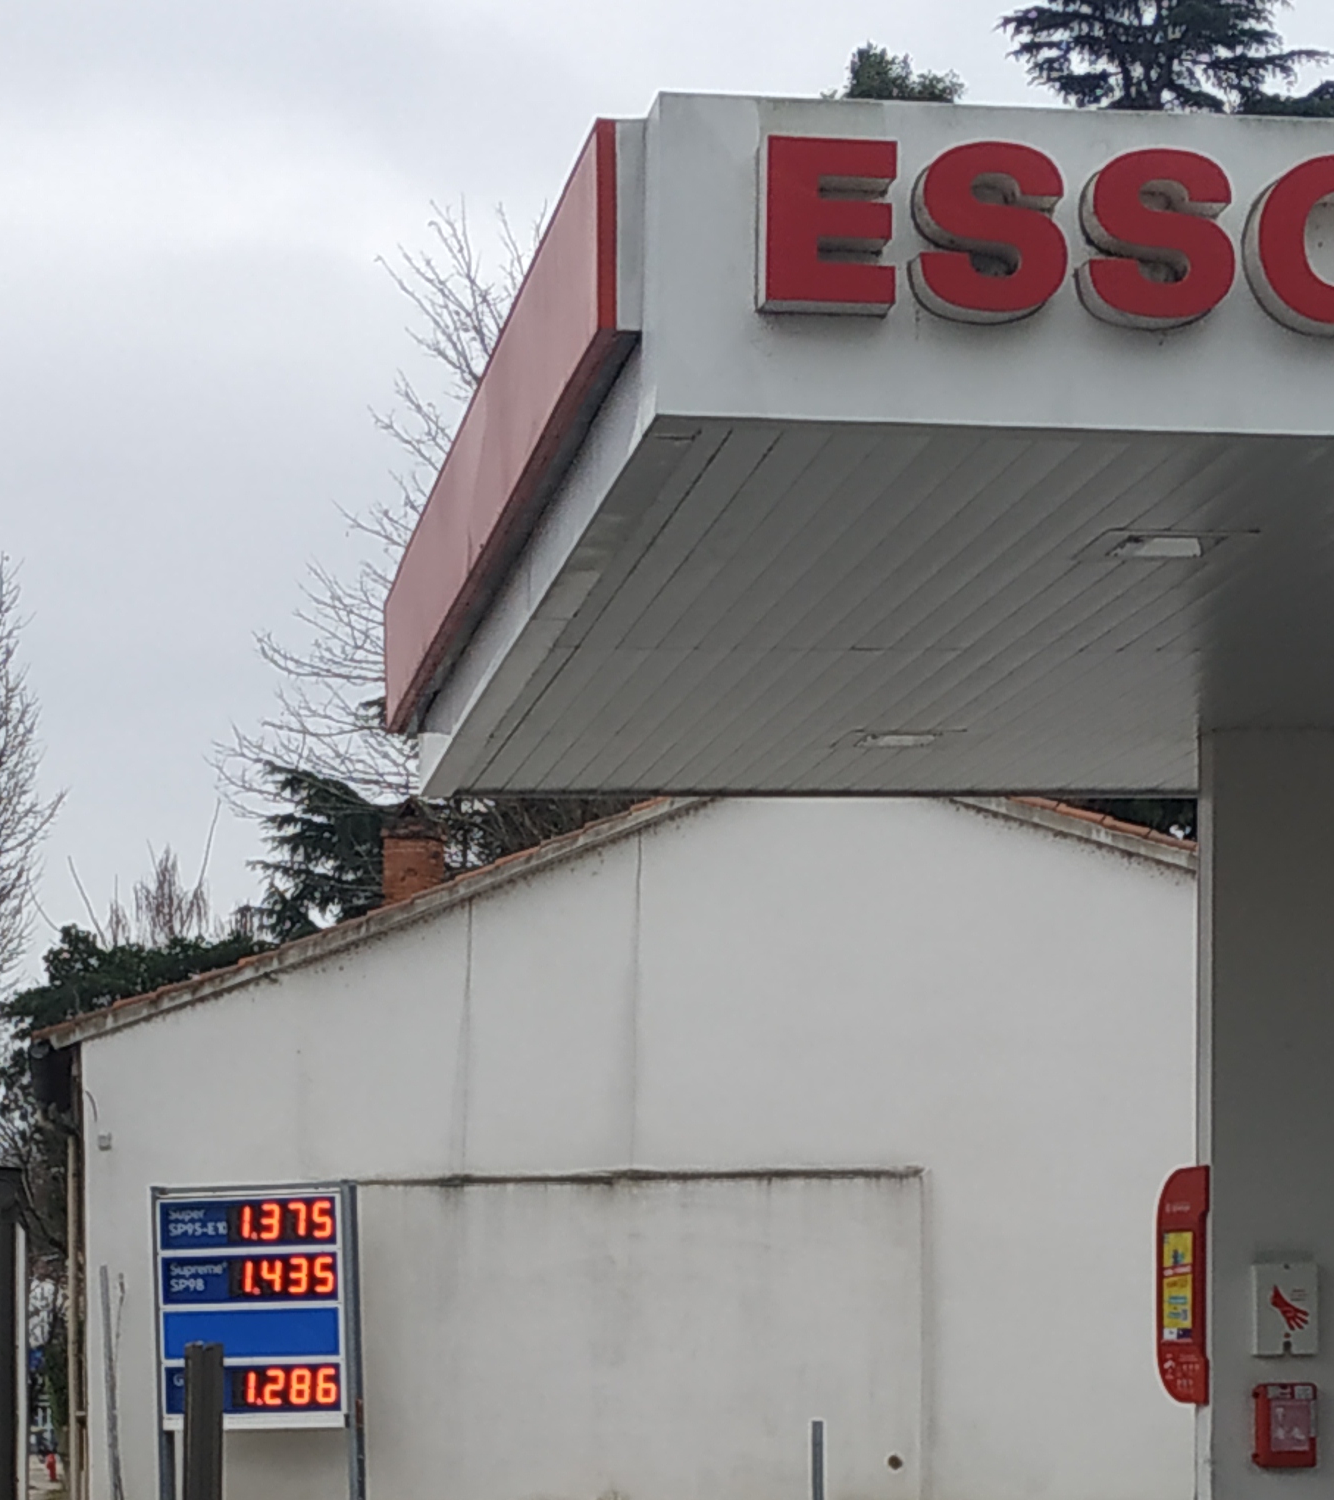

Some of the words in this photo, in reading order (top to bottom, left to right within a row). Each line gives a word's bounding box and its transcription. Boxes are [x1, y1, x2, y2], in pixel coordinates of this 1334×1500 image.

[168, 1208, 205, 1221] Super
[240, 1200, 334, 1241] 1.375
[168, 1222, 228, 1236] SP95-E10
[170, 1278, 205, 1291] SP98
[243, 1255, 335, 1295] 1.435
[246, 1366, 337, 1406] 1.286
